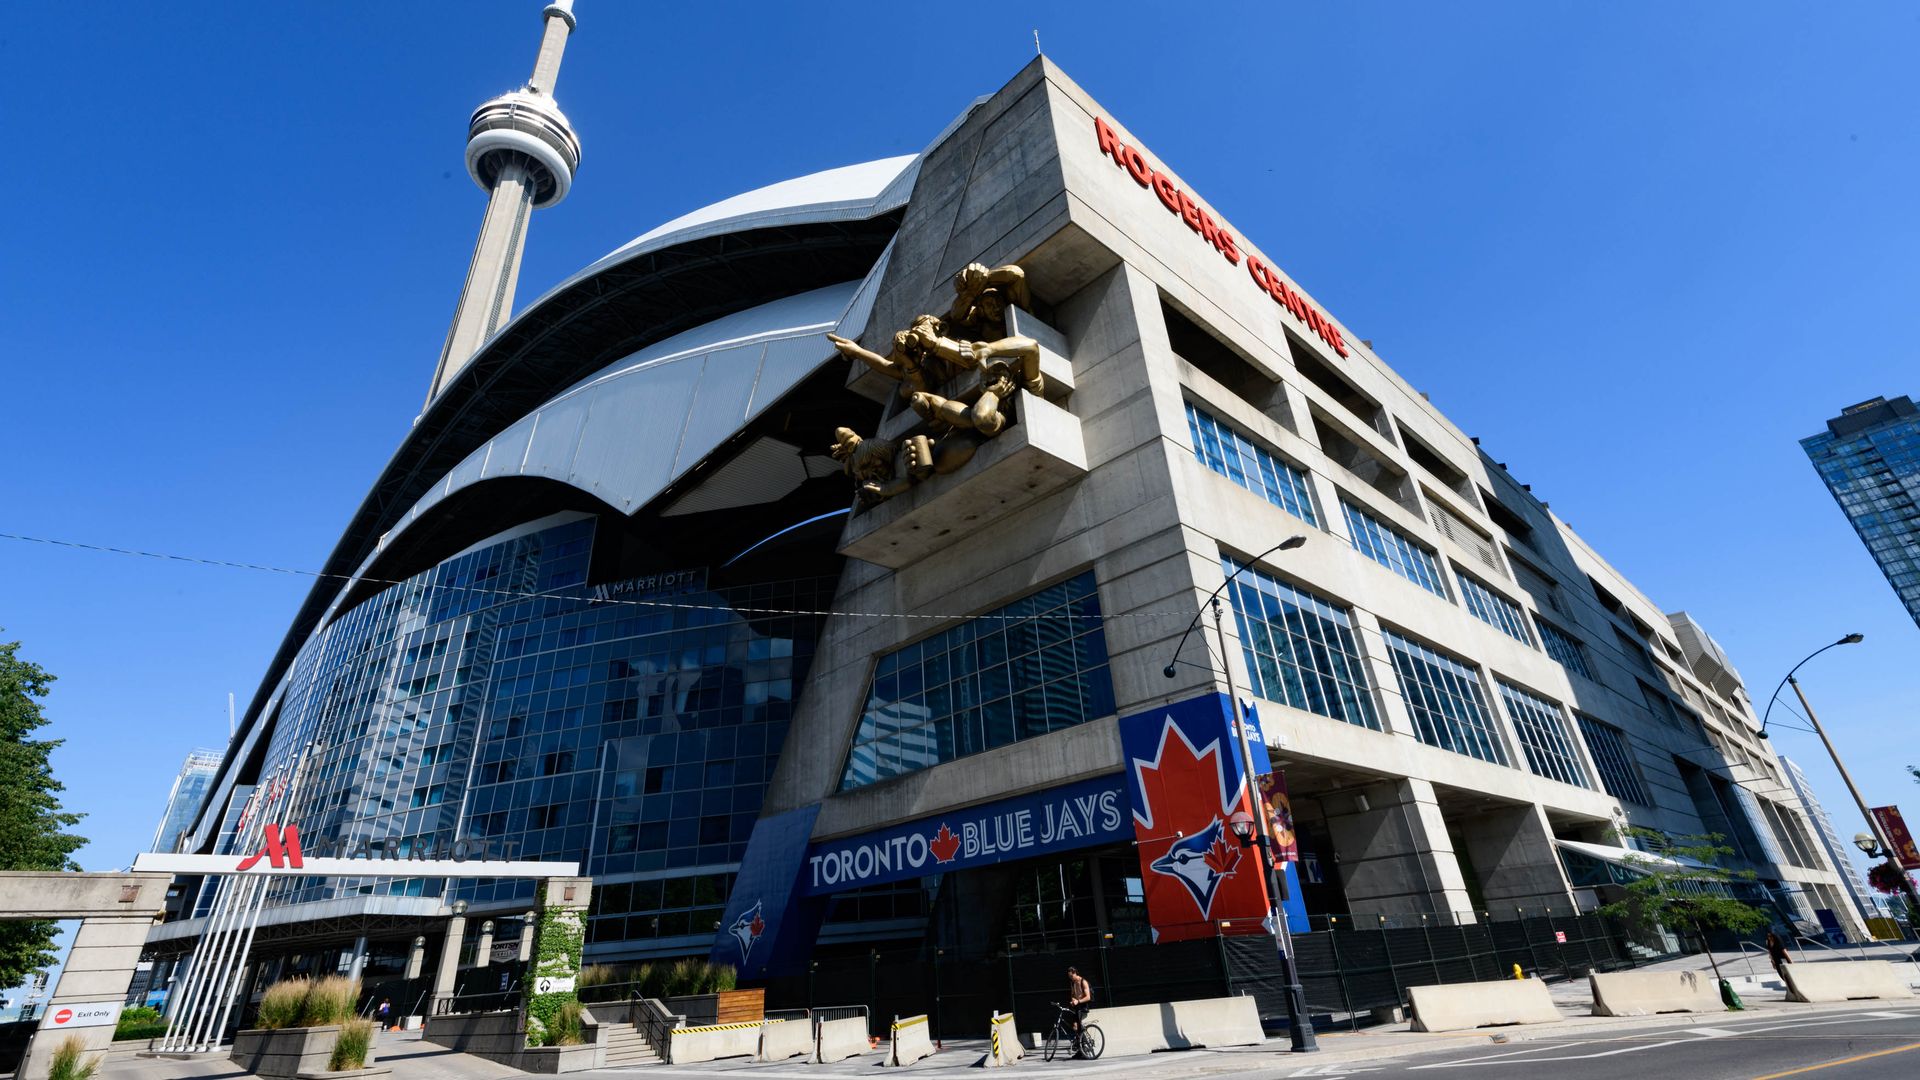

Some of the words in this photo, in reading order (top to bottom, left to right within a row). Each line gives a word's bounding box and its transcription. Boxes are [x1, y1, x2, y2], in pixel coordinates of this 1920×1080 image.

[1095, 116, 1240, 266] ROGERS
[1247, 254, 1349, 359] CENTRE
[613, 570, 696, 594] MARRIOTT
[315, 835, 520, 863] MARRIOTT
[809, 832, 929, 887] TORONTO
[962, 809, 1035, 859] BLUE
[1040, 790, 1122, 844] JAYS
